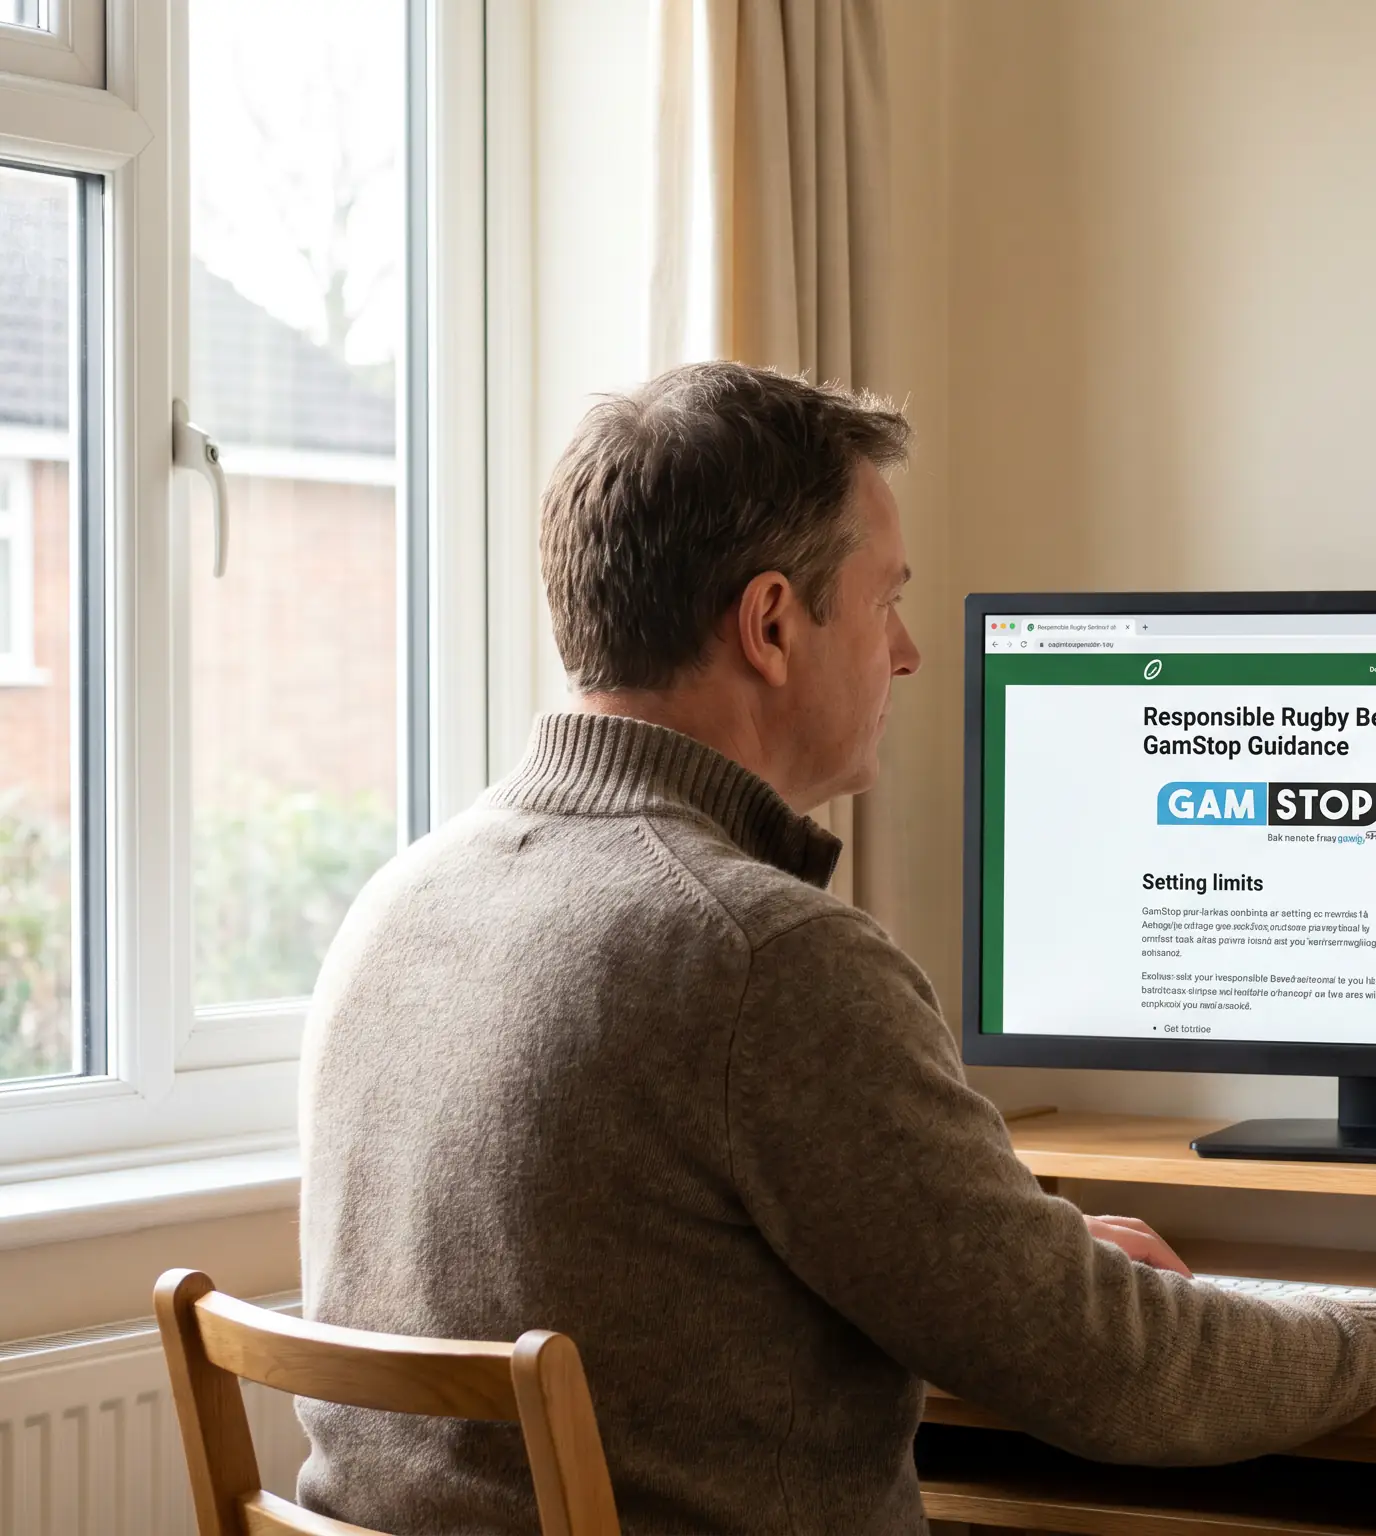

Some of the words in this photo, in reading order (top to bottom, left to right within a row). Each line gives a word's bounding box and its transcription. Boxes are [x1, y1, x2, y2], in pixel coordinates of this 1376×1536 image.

[1143, 706, 1275, 731] Responsible
[1281, 707, 1349, 732] Rugby
[1143, 735, 1241, 760] GamStop
[1247, 736, 1350, 756] Guidance
[1168, 788, 1255, 819] GAM
[1276, 789, 1373, 821] STOP
[1142, 873, 1207, 895] Setting
[1213, 873, 1264, 892] limits
[1142, 907, 1182, 917] GamStop
[1281, 909, 1312, 919] setting
[1289, 939, 1306, 947] you
[1194, 974, 1213, 983] your
[1347, 977, 1364, 986] you
[1182, 1002, 1198, 1010] you
[1164, 1025, 1179, 1033] Get
